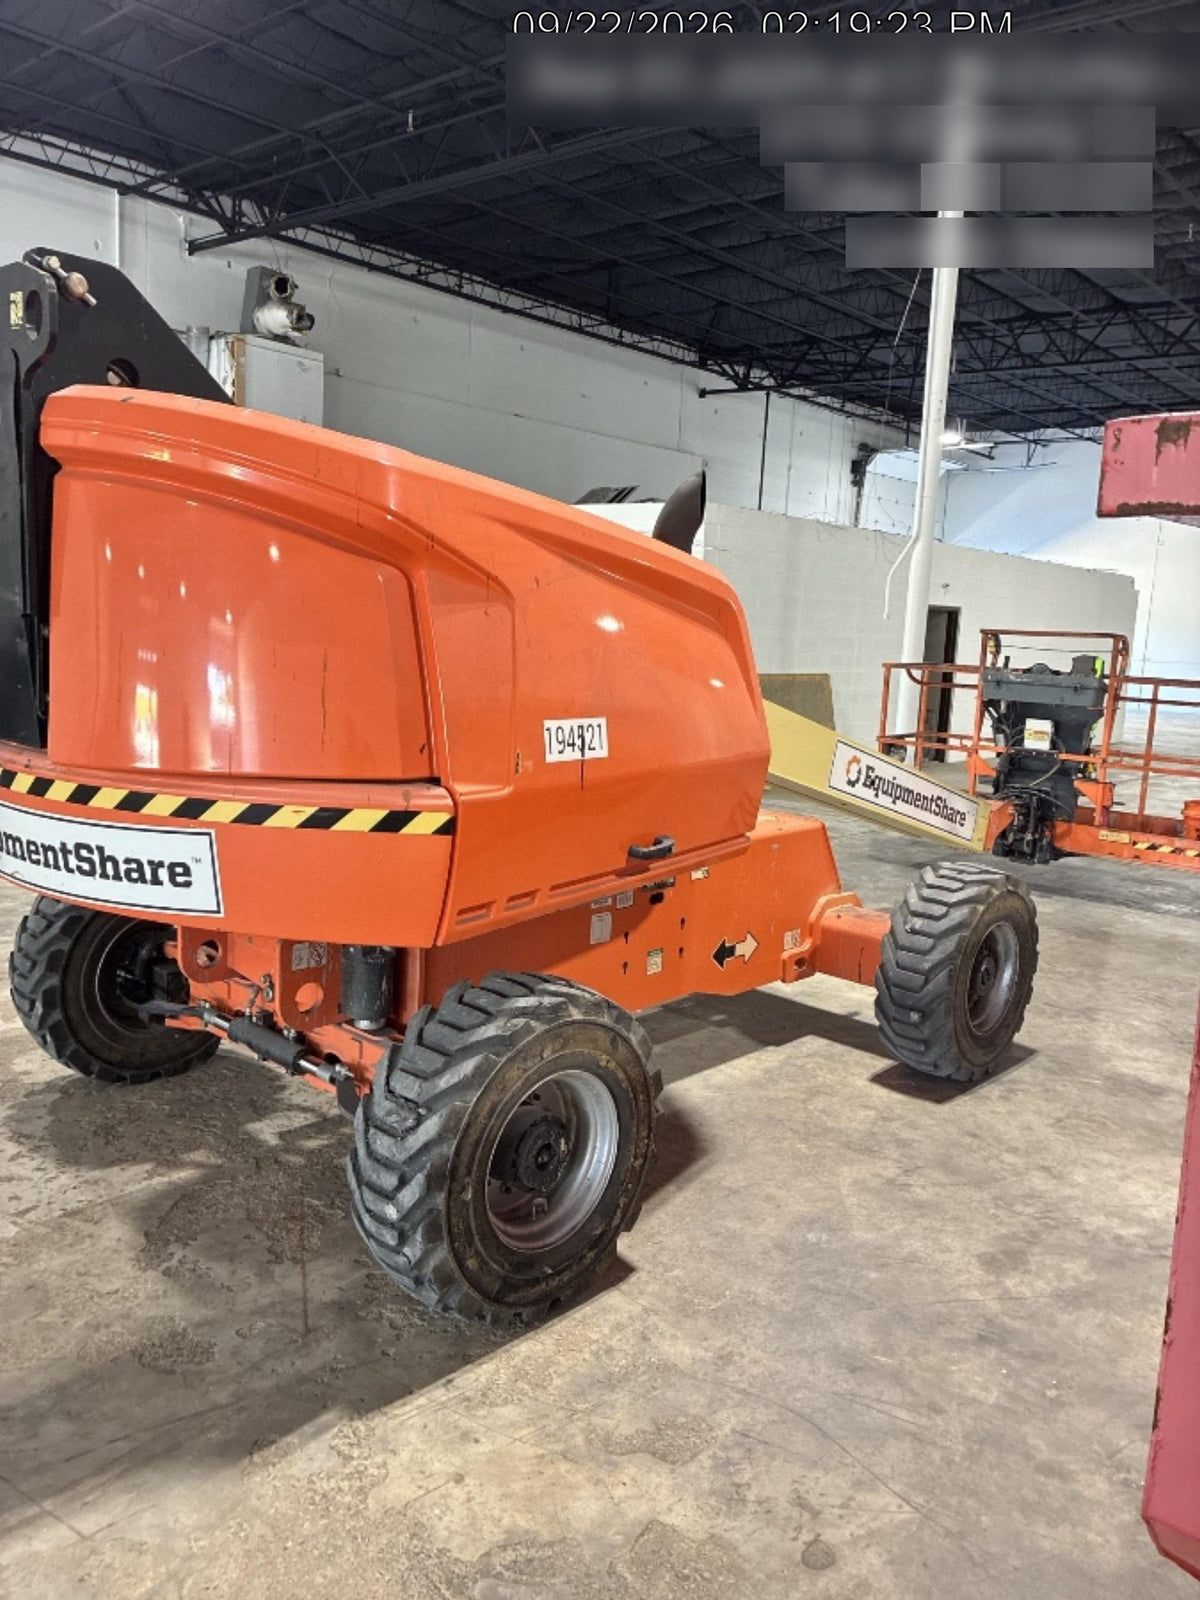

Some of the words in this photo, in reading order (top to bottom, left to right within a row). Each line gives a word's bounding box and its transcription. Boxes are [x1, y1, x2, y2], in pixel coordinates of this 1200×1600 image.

[546, 723, 603, 756] 194521
[862, 764, 967, 828] EquipmentShare
[0, 831, 193, 888] mentShare
